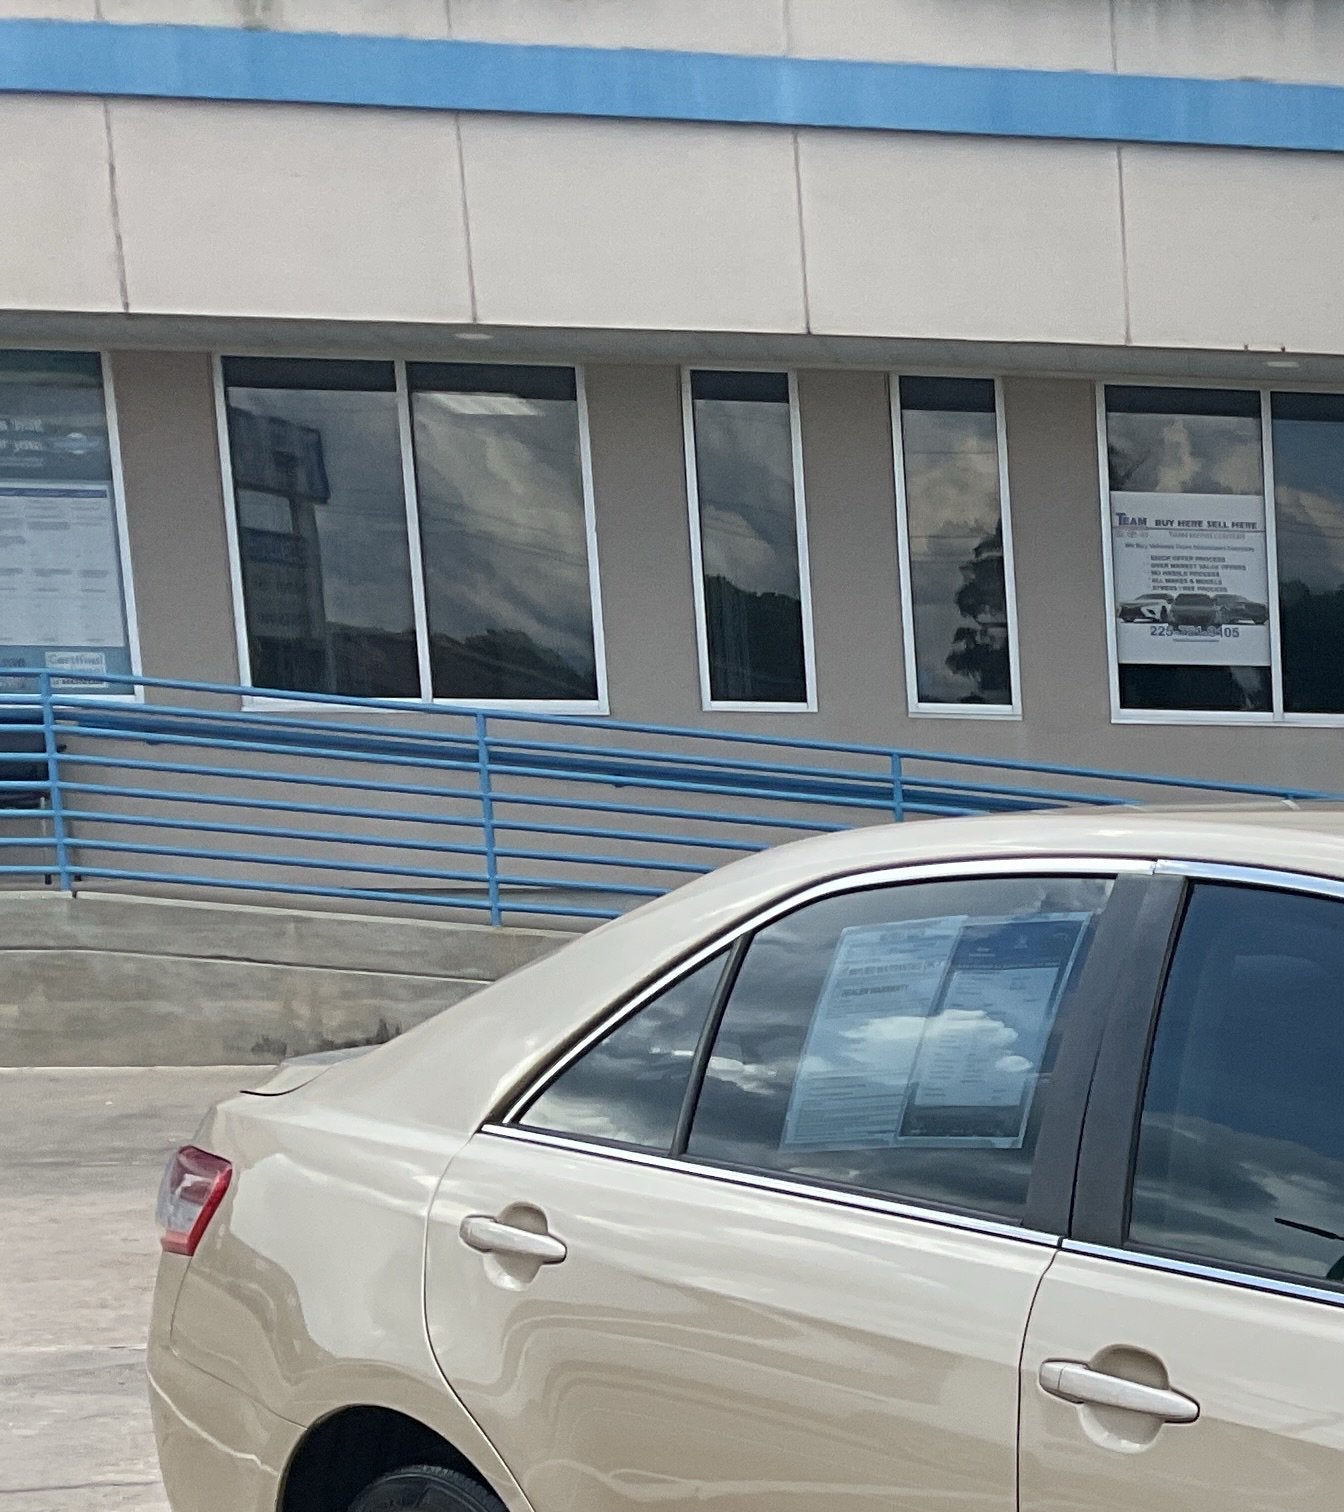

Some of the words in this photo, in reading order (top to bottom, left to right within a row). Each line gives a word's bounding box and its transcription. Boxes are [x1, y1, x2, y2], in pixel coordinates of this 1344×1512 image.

[1116, 512, 1148, 525] TEAM
[1154, 519, 1174, 527] BUY
[1177, 520, 1203, 528] HERE
[1206, 520, 1229, 528] SELL
